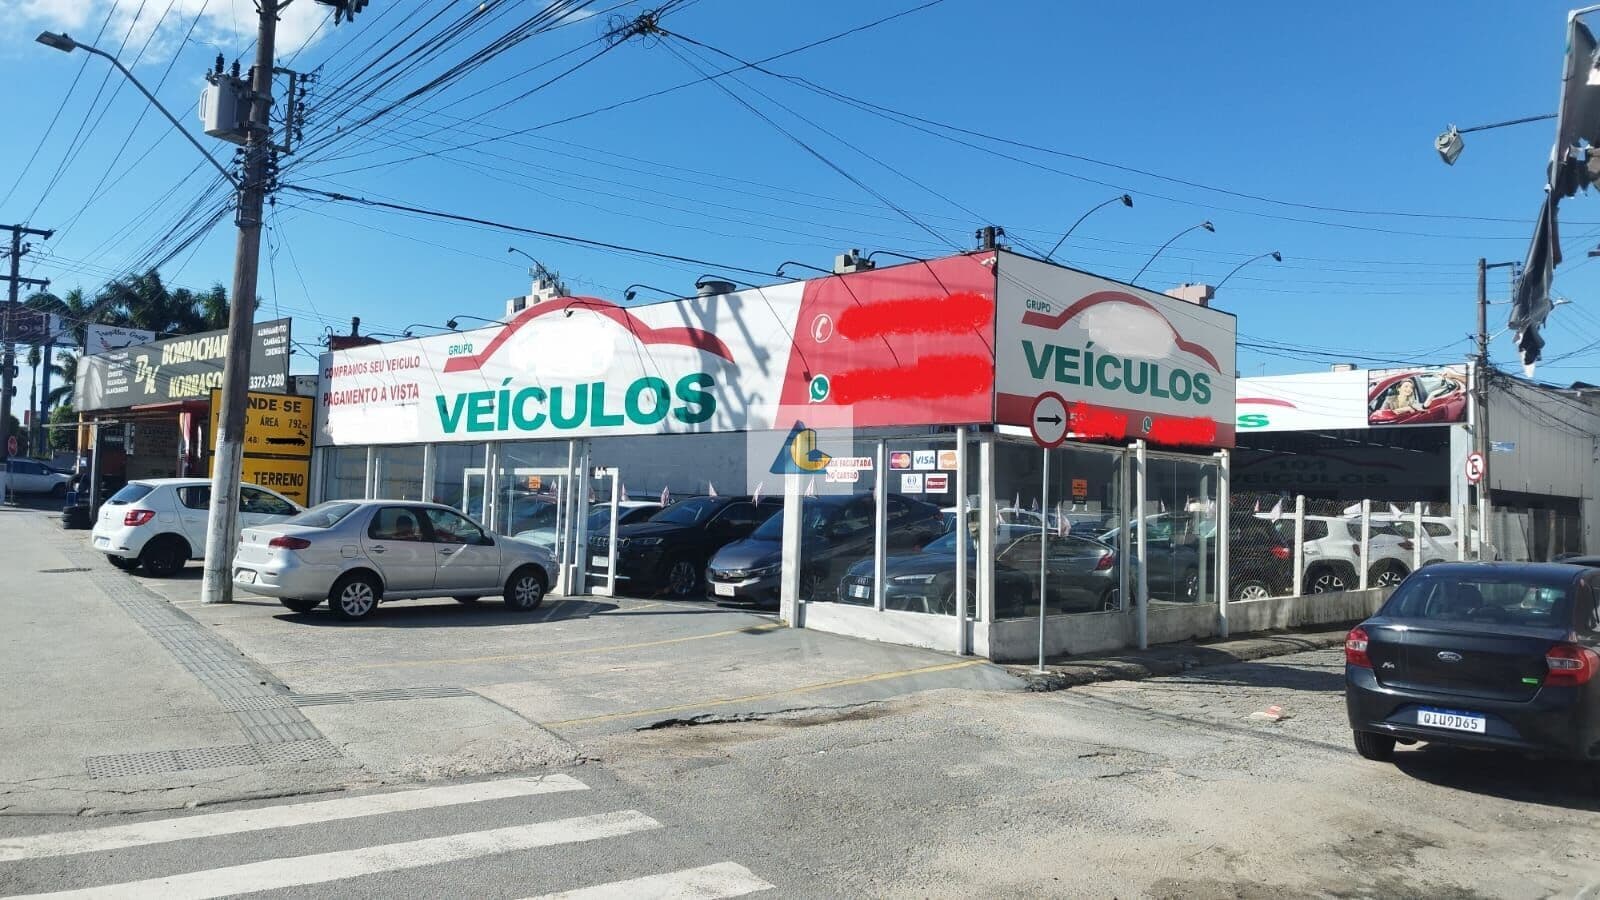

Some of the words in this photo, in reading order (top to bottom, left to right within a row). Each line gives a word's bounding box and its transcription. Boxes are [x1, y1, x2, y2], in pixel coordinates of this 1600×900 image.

[1026, 299, 1051, 313] GRUPO
[448, 343, 473, 355] GRUPO
[324, 362, 368, 379] COMPRAMOS
[369, 360, 385, 374] SEU
[1021, 340, 1212, 405] VEÍCULOS
[323, 386, 378, 407] PAGAMENTO
[390, 383, 420, 402] VISTA
[435, 372, 717, 434] VEÍCULOS
[915, 455, 935, 465] VISA
[254, 472, 304, 487] TERRENO
